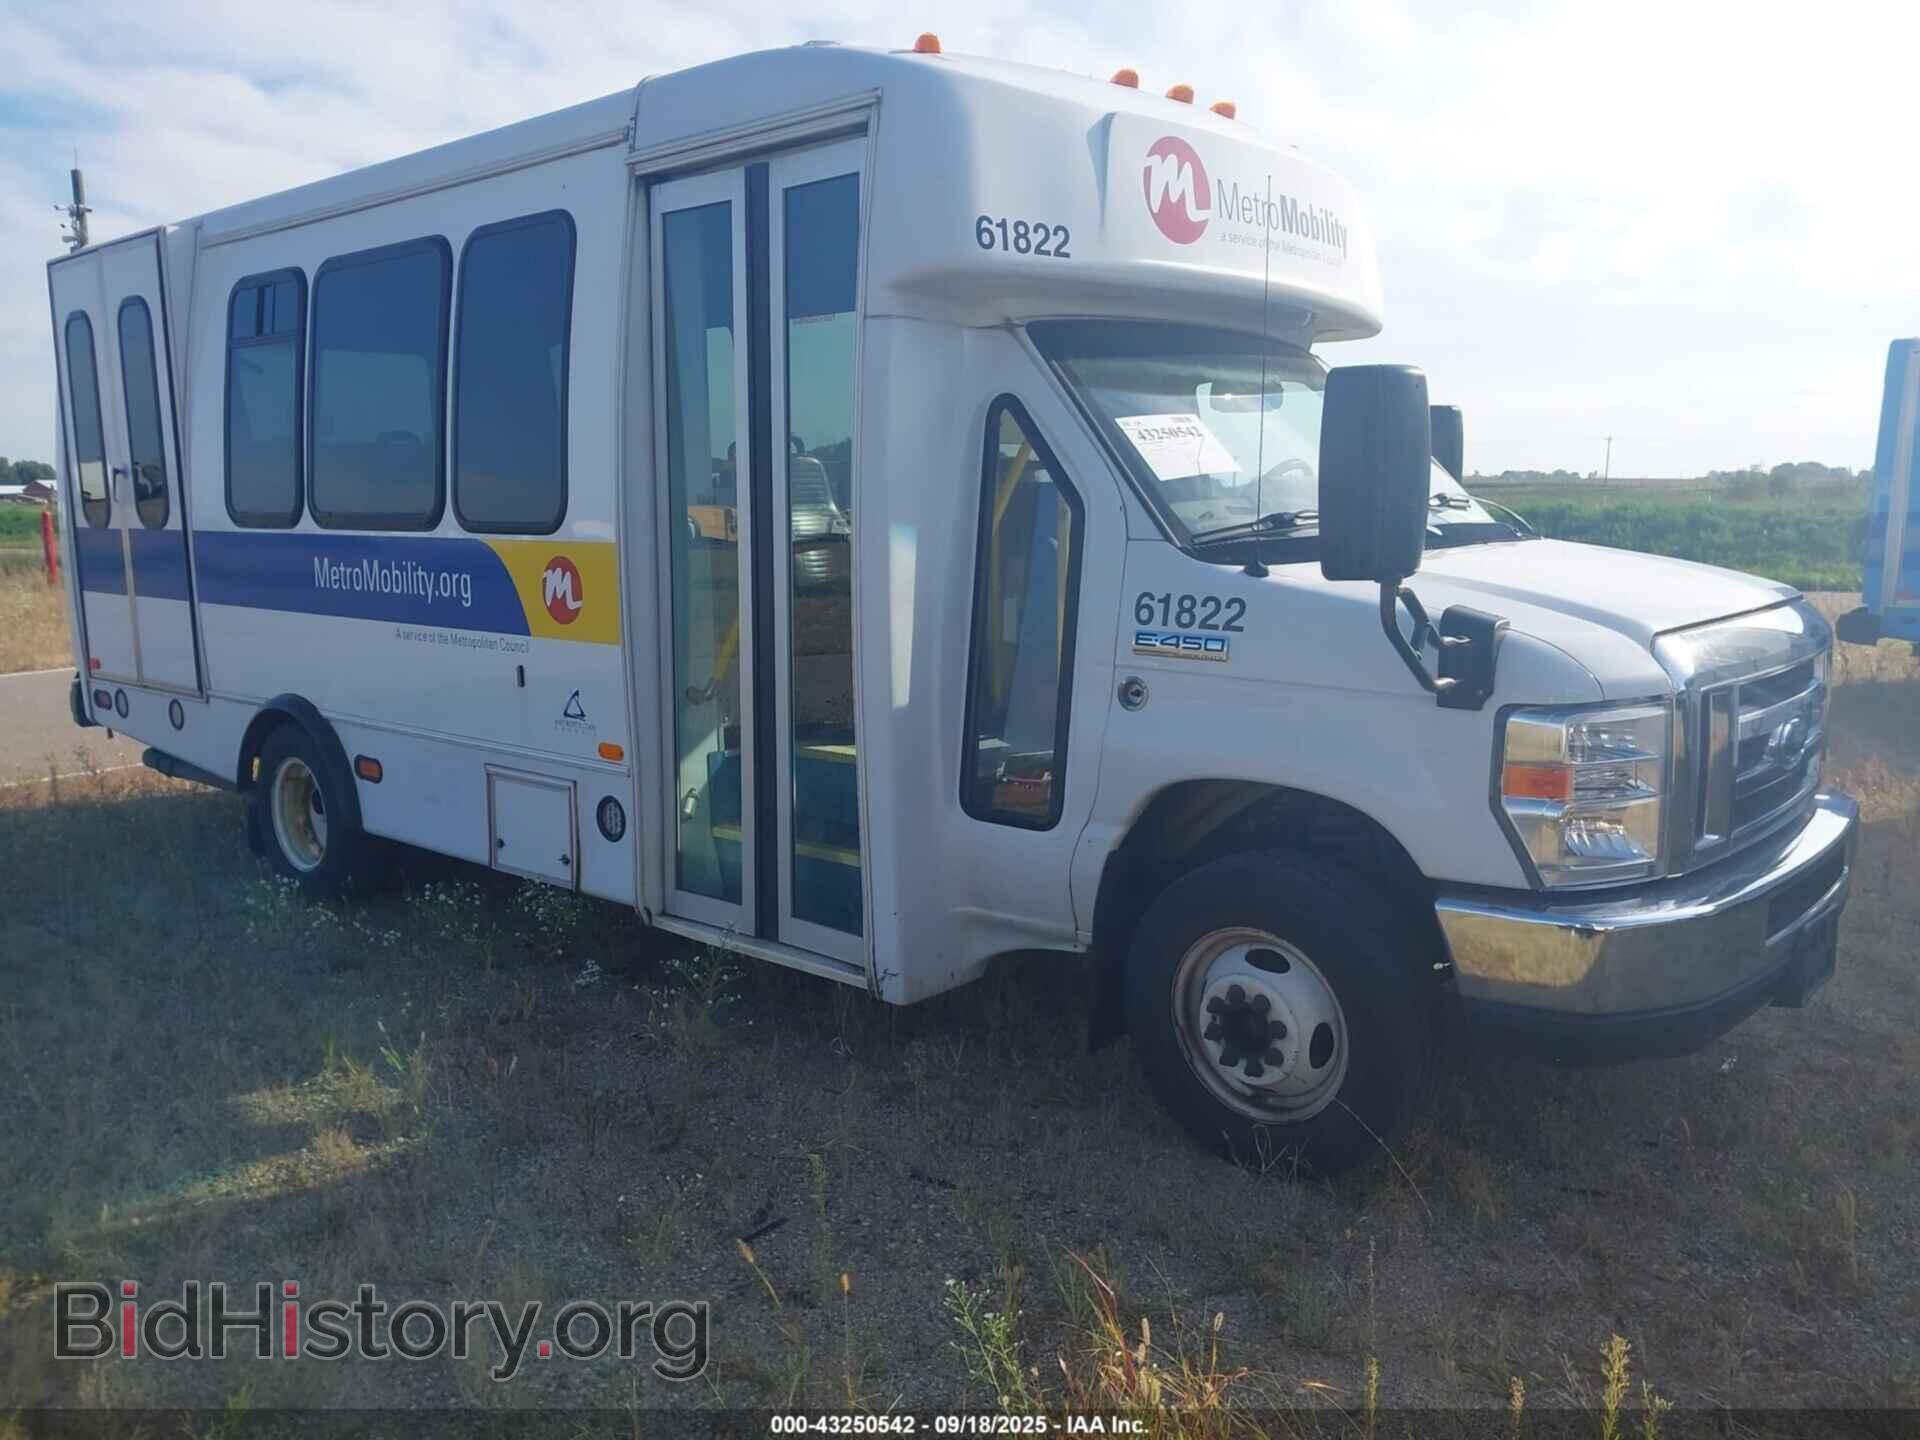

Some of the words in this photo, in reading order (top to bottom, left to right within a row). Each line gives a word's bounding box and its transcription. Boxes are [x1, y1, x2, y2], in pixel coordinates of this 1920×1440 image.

[976, 215, 1071, 258] 61822
[1217, 178, 1347, 259] MetroMobility
[1137, 426, 1203, 441] 43250542
[313, 556, 471, 607] MetroMobility.org
[1135, 592, 1246, 632] 61822
[403, 630, 428, 642] service
[450, 633, 498, 650] Metropolitan
[500, 637, 529, 654] Council
